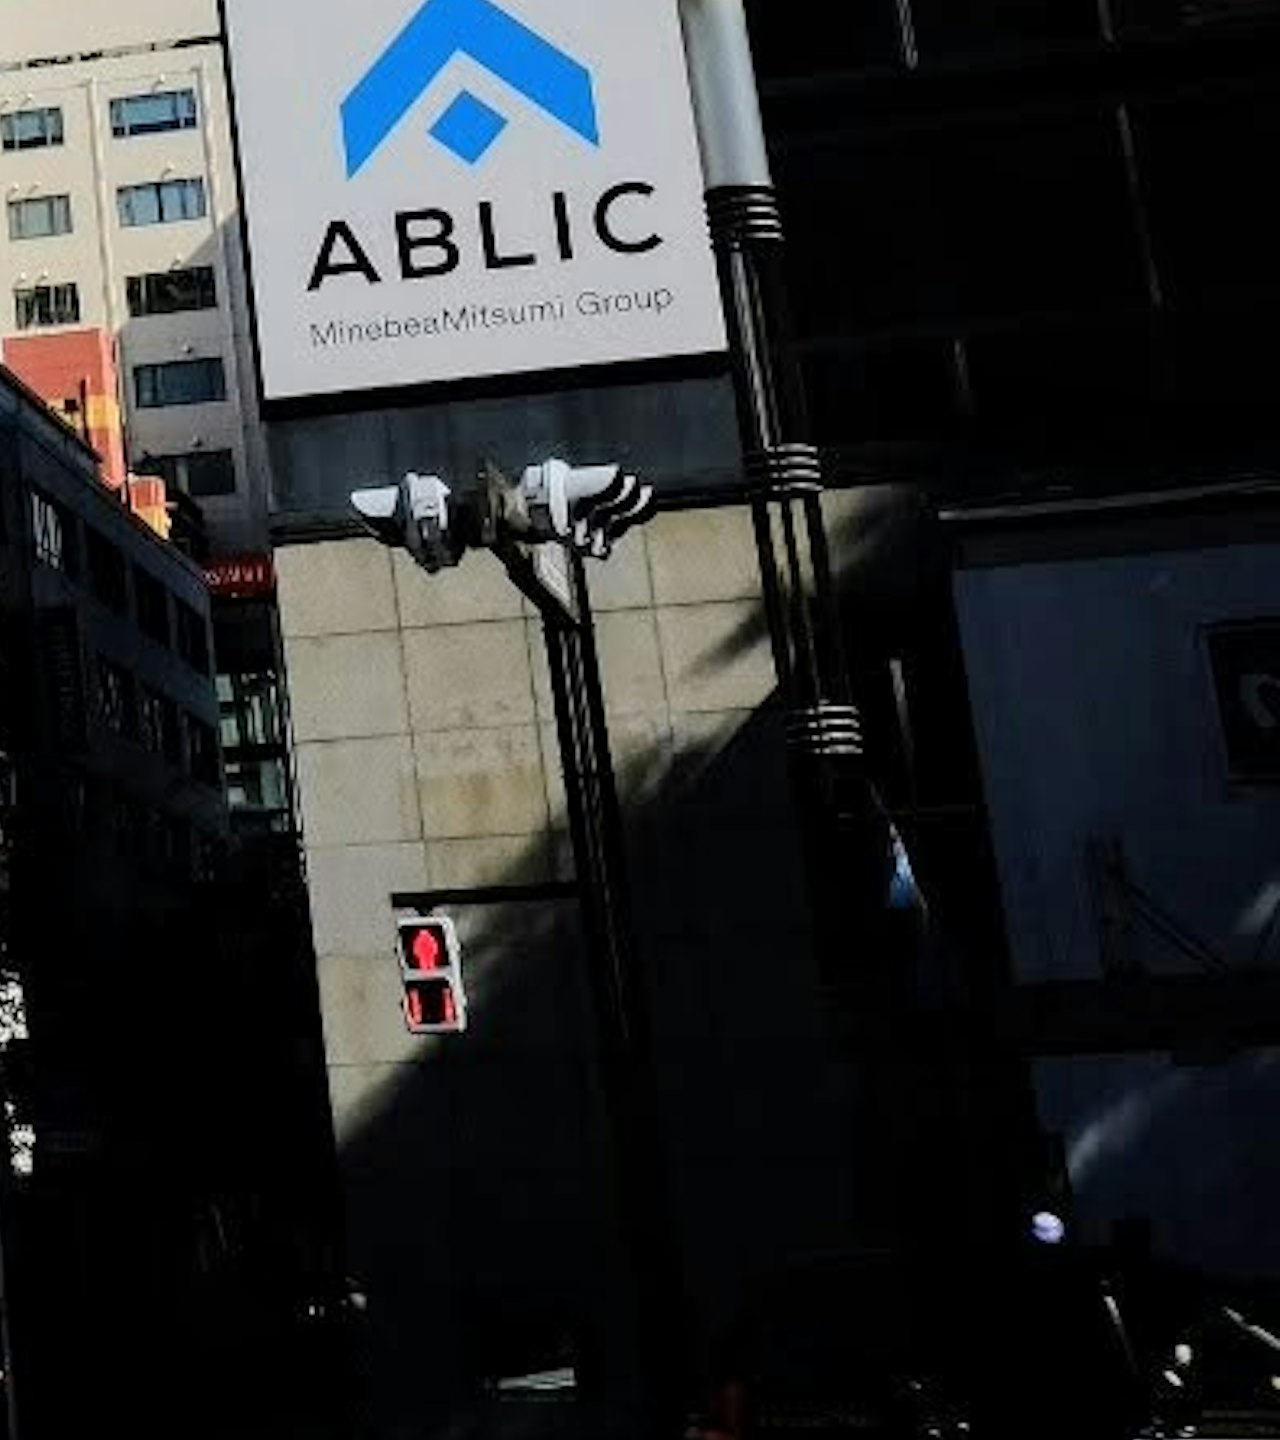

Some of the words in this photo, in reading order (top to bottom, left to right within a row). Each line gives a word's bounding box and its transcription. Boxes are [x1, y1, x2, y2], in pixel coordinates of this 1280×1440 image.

[306, 181, 663, 291] ABLIC
[310, 294, 565, 348] MinebeaMitsumi
[575, 287, 675, 316] Group
